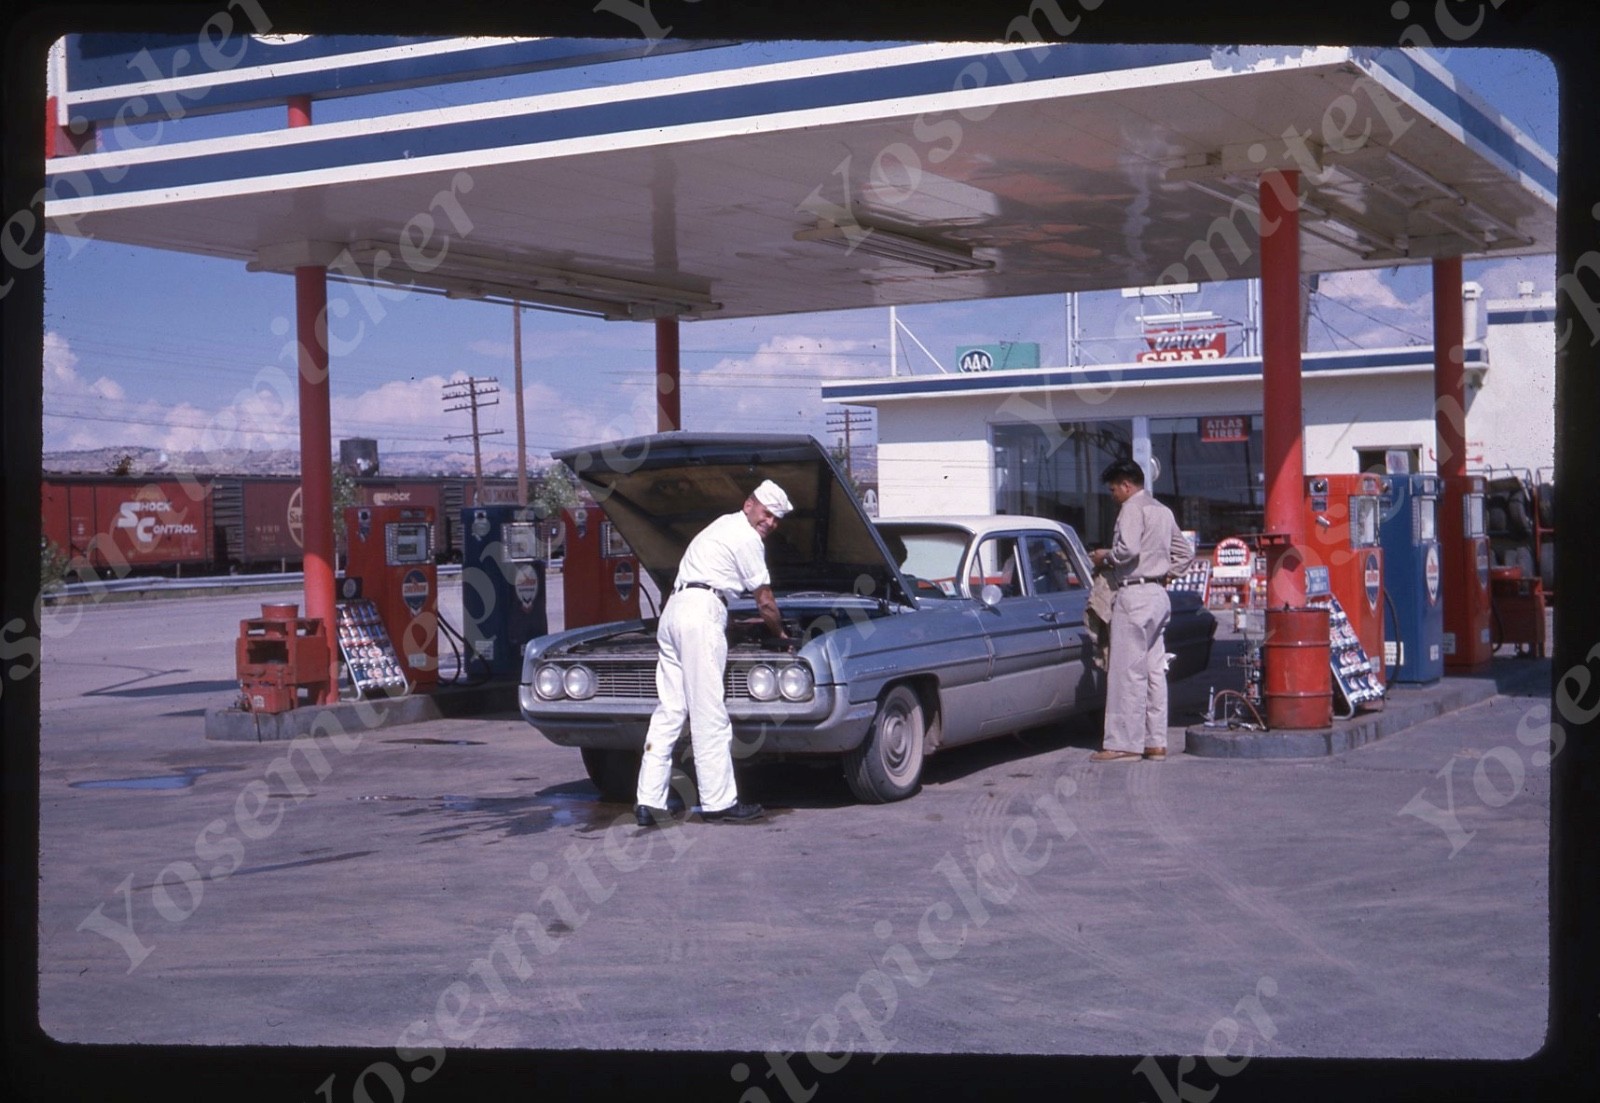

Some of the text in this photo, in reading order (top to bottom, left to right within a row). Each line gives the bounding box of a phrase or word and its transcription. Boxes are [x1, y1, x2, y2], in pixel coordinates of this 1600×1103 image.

[963, 353, 990, 372] AAA
[1206, 418, 1243, 429] ATLAS
[1208, 429, 1241, 438] TIRES
[117, 502, 171, 528] SHOCK
[137, 517, 197, 542] CONTROL
